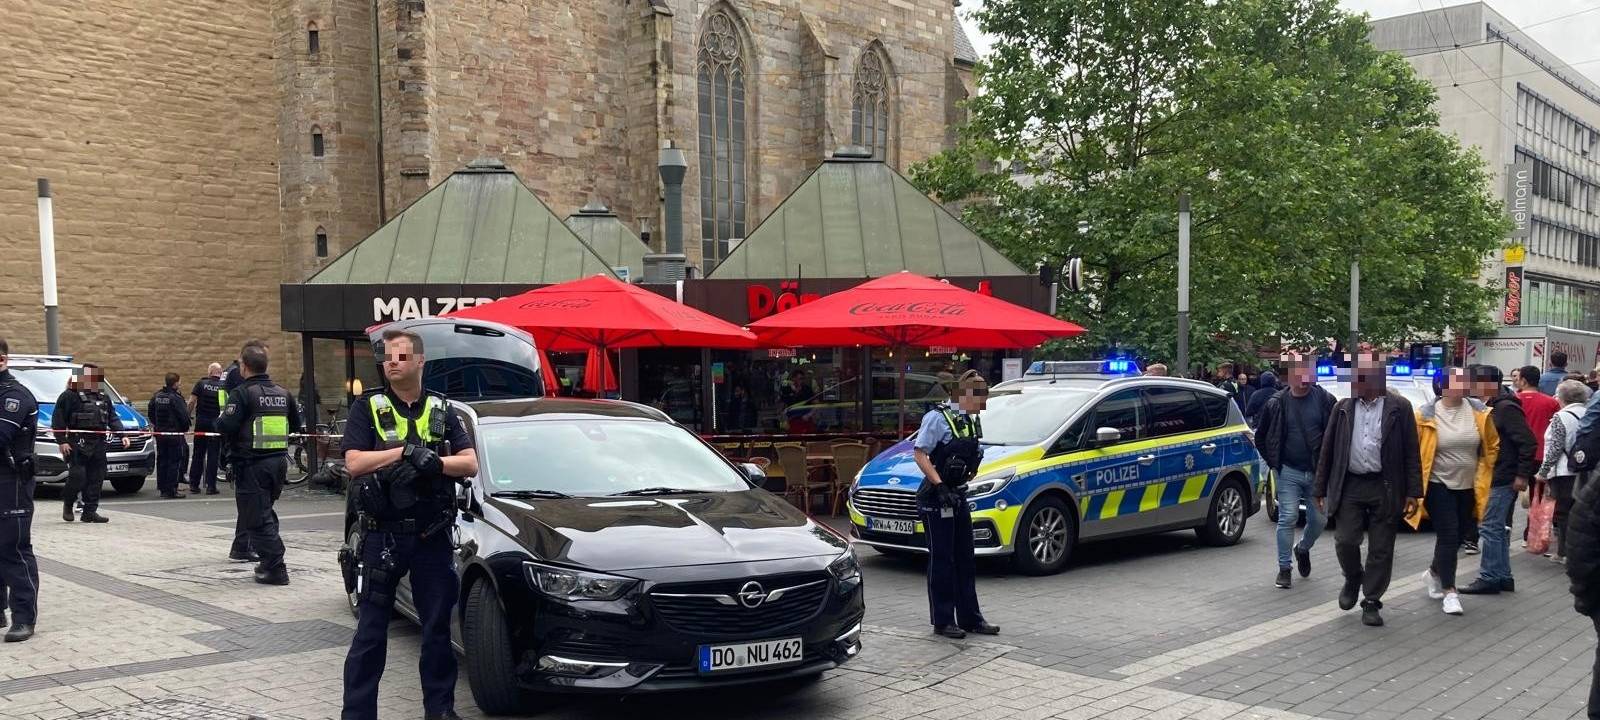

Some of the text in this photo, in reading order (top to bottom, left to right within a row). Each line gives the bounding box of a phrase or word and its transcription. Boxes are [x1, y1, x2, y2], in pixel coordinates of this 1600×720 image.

[849, 302, 967, 315] Coca-Cola
[259, 397, 287, 407] POLIZEI
[1096, 464, 1140, 486] POLIZEI
[712, 640, 801, 668] DO NU 462
